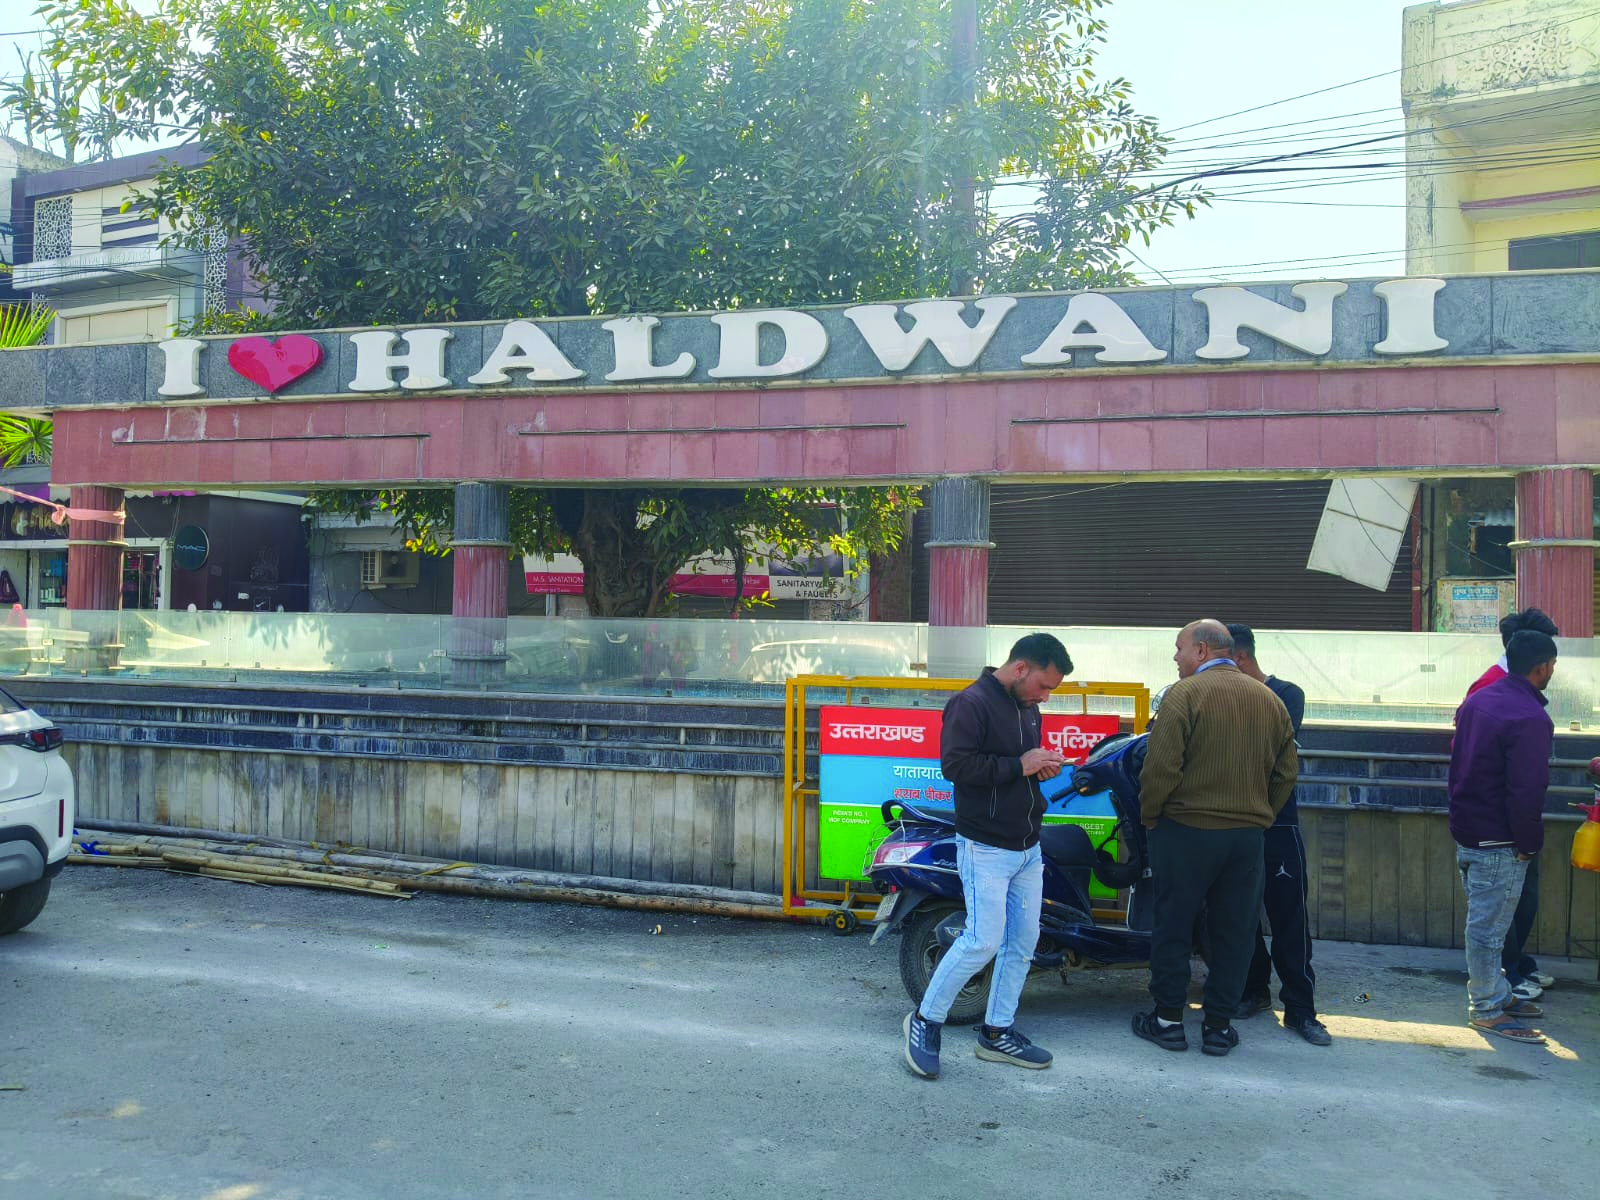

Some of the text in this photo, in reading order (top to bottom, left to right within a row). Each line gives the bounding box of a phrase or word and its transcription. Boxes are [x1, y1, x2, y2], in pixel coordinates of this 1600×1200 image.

[158, 279, 1449, 396] I HALDWANI
[803, 590, 838, 599] FAUCETS
[829, 723, 926, 743] उत्तराखण्ड
[923, 785, 953, 801] पीकर
